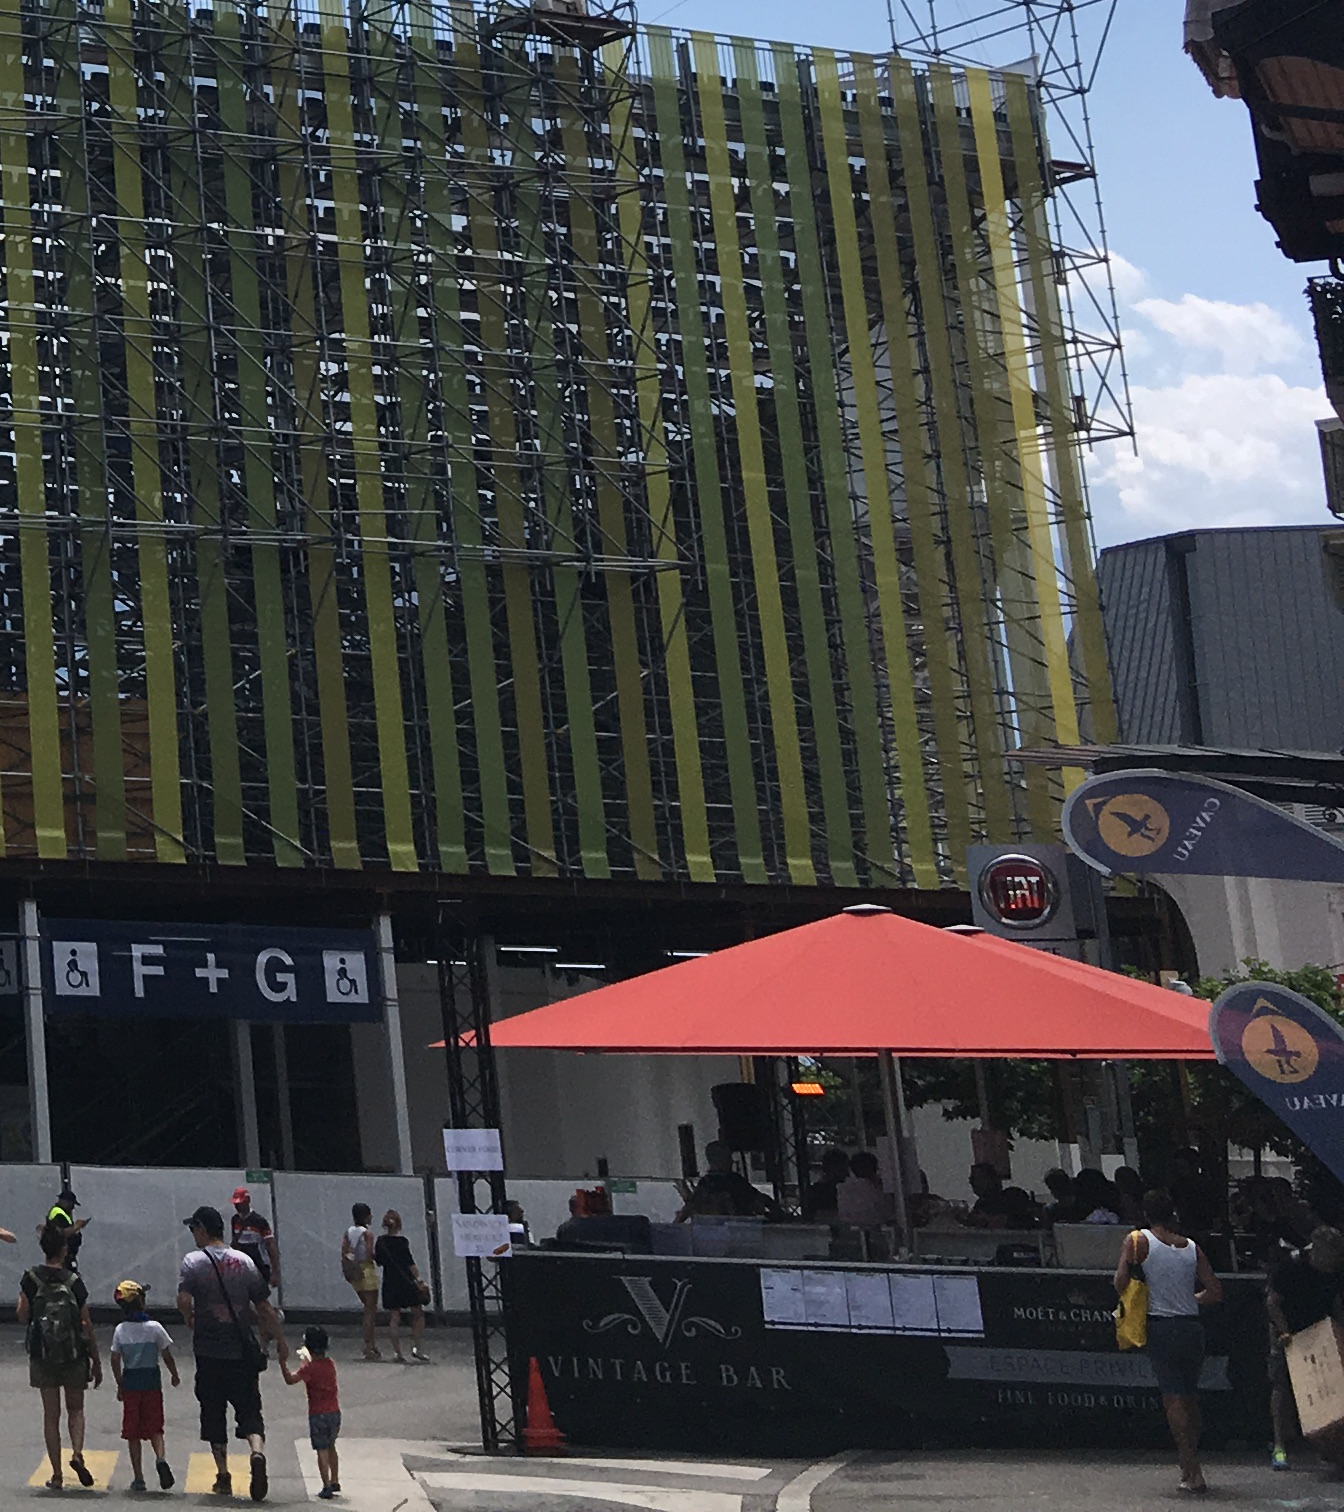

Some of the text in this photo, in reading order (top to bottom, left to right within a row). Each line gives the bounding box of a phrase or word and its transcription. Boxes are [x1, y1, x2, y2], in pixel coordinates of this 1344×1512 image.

[131, 943, 165, 998] F
[255, 947, 297, 1003] G
[1070, 1308, 1113, 1323] CHAN
[548, 1355, 792, 1390] VINTAGE BAR
[1113, 1394, 1159, 1410] DRIN
